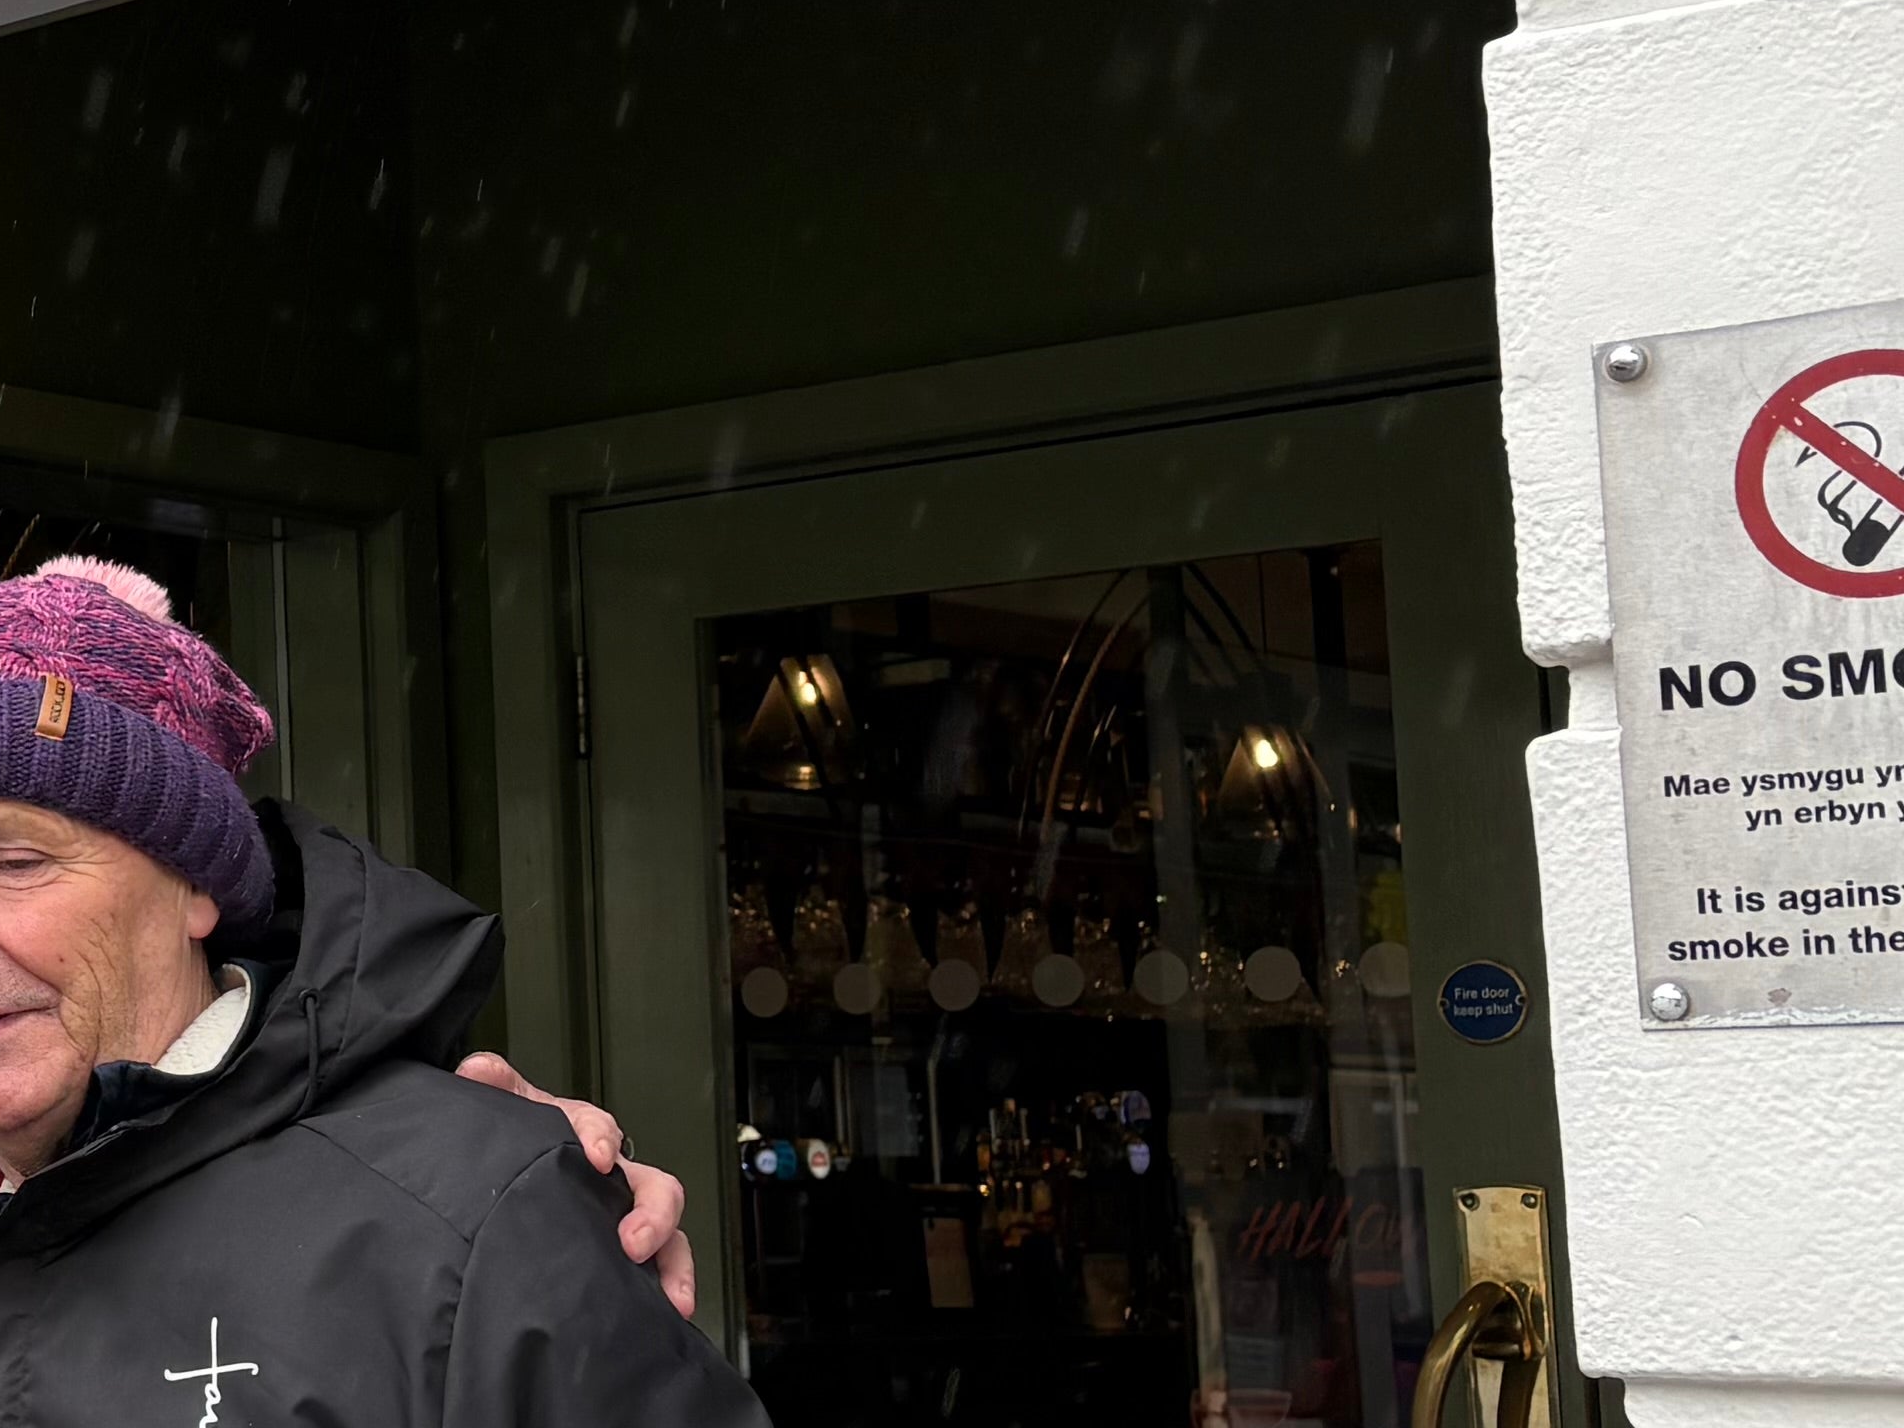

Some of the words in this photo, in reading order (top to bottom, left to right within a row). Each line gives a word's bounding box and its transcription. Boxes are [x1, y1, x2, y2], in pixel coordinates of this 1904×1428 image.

[1659, 660, 1757, 711] NO
[1663, 774, 1731, 798] Mae
[1740, 767, 1865, 798] ysmygu
[1744, 808, 1783, 832] yn
[1794, 799, 1886, 826] erbyn
[1697, 887, 1723, 915] It
[1734, 885, 1766, 913] is
[1778, 880, 1904, 916] agains
[1668, 931, 1790, 962] smoke
[1802, 928, 1836, 956] in
[1454, 987, 1478, 1000] Fire
[1481, 986, 1510, 1000] door
[1453, 1004, 1483, 1018] keep
[1486, 1002, 1514, 1015] shut
